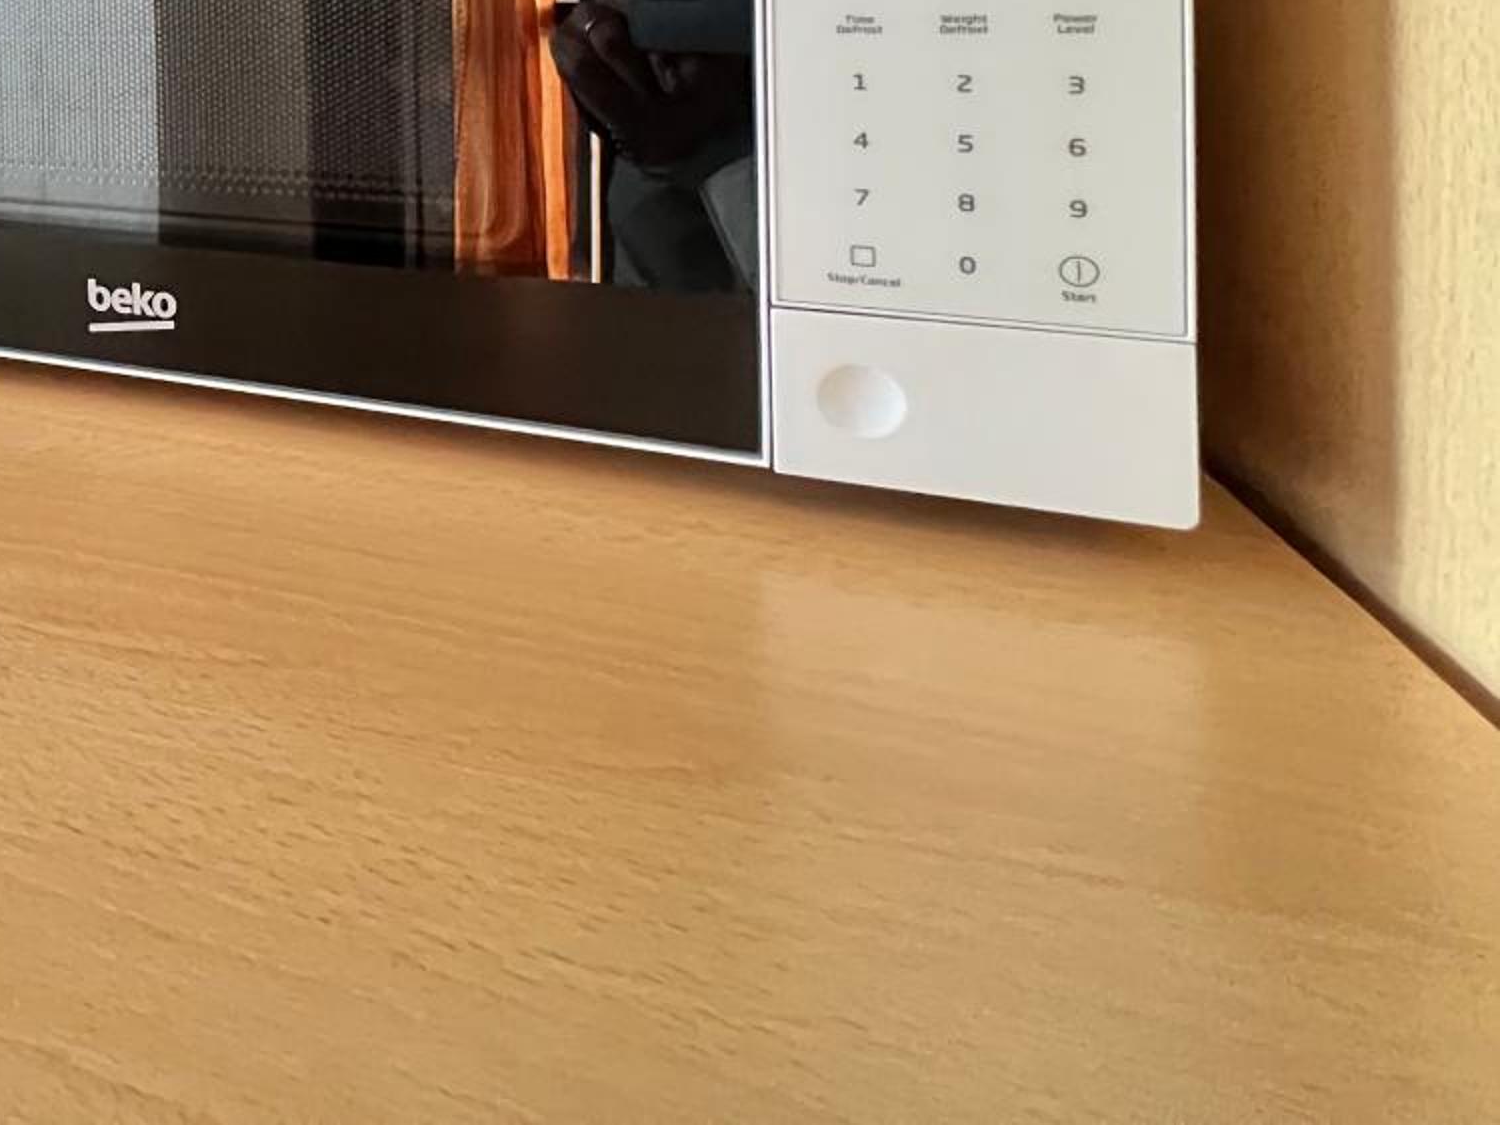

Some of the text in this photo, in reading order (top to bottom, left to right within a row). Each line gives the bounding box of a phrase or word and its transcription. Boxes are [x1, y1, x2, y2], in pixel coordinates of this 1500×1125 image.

[1057, 25, 1095, 34] Level
[853, 73, 867, 91] 1
[957, 75, 972, 93] 2
[1068, 75, 1085, 95] 3
[853, 132, 869, 149] 4
[958, 134, 974, 153] 5
[1068, 138, 1087, 157] 6
[854, 189, 870, 206] 7
[958, 193, 975, 212] 8
[1069, 199, 1088, 219] 9
[959, 256, 977, 275] 0
[88, 279, 176, 318] beko
[1061, 290, 1097, 303] Start
